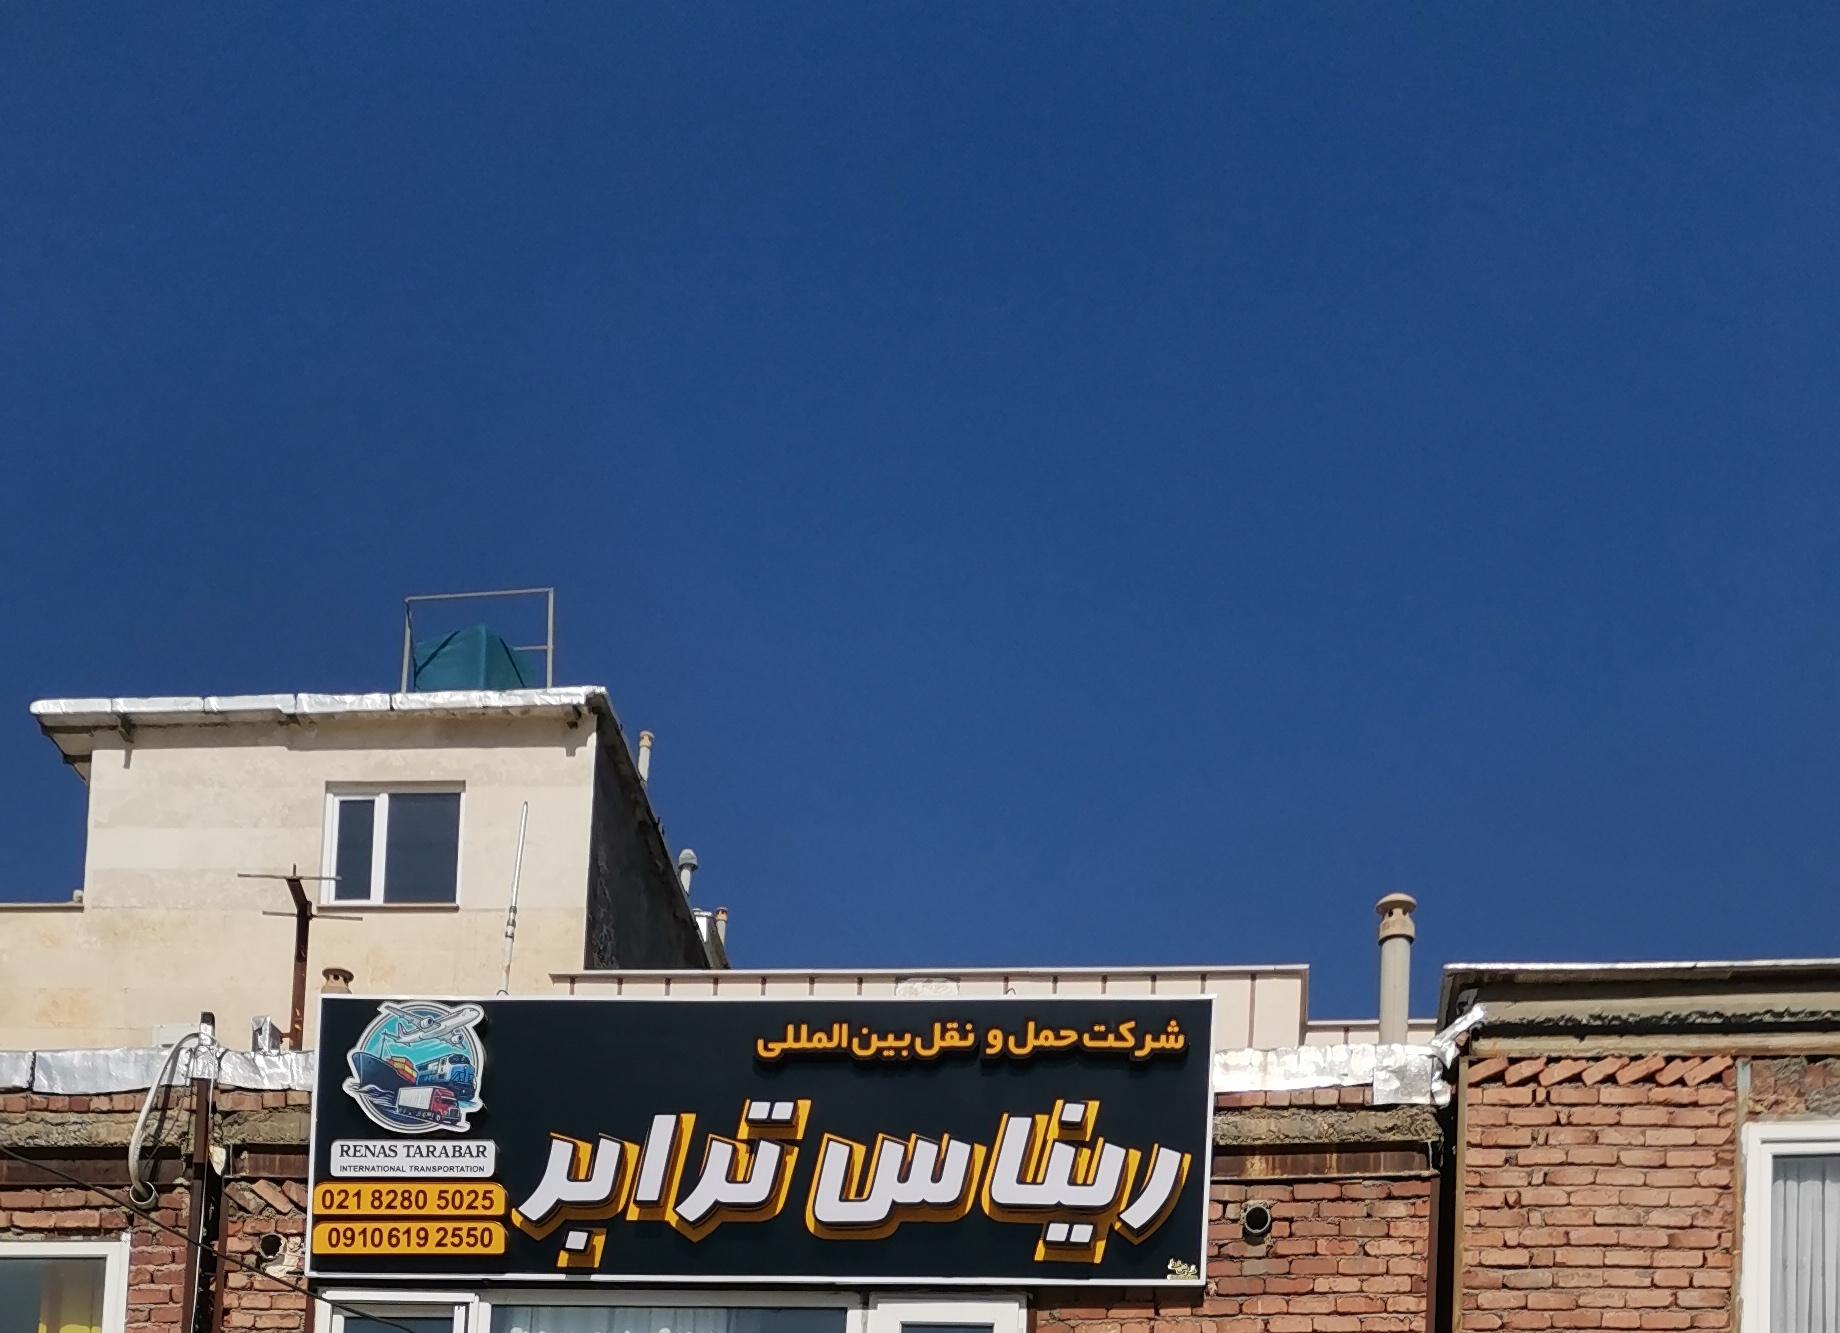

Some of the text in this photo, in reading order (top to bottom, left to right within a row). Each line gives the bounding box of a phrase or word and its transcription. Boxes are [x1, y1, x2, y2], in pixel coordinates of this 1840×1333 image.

[757, 1019, 1185, 1058] شرکت حمل و نقل بین المللی
[339, 1144, 487, 1158] RENAS TARABAR
[340, 1165, 485, 1173] INTERNATIONAL TRANSPORTATION
[513, 1100, 1188, 1264] ریناس ترابر
[321, 1189, 494, 1210] 021 8280 5025
[435, 1227, 494, 1248] 2550
